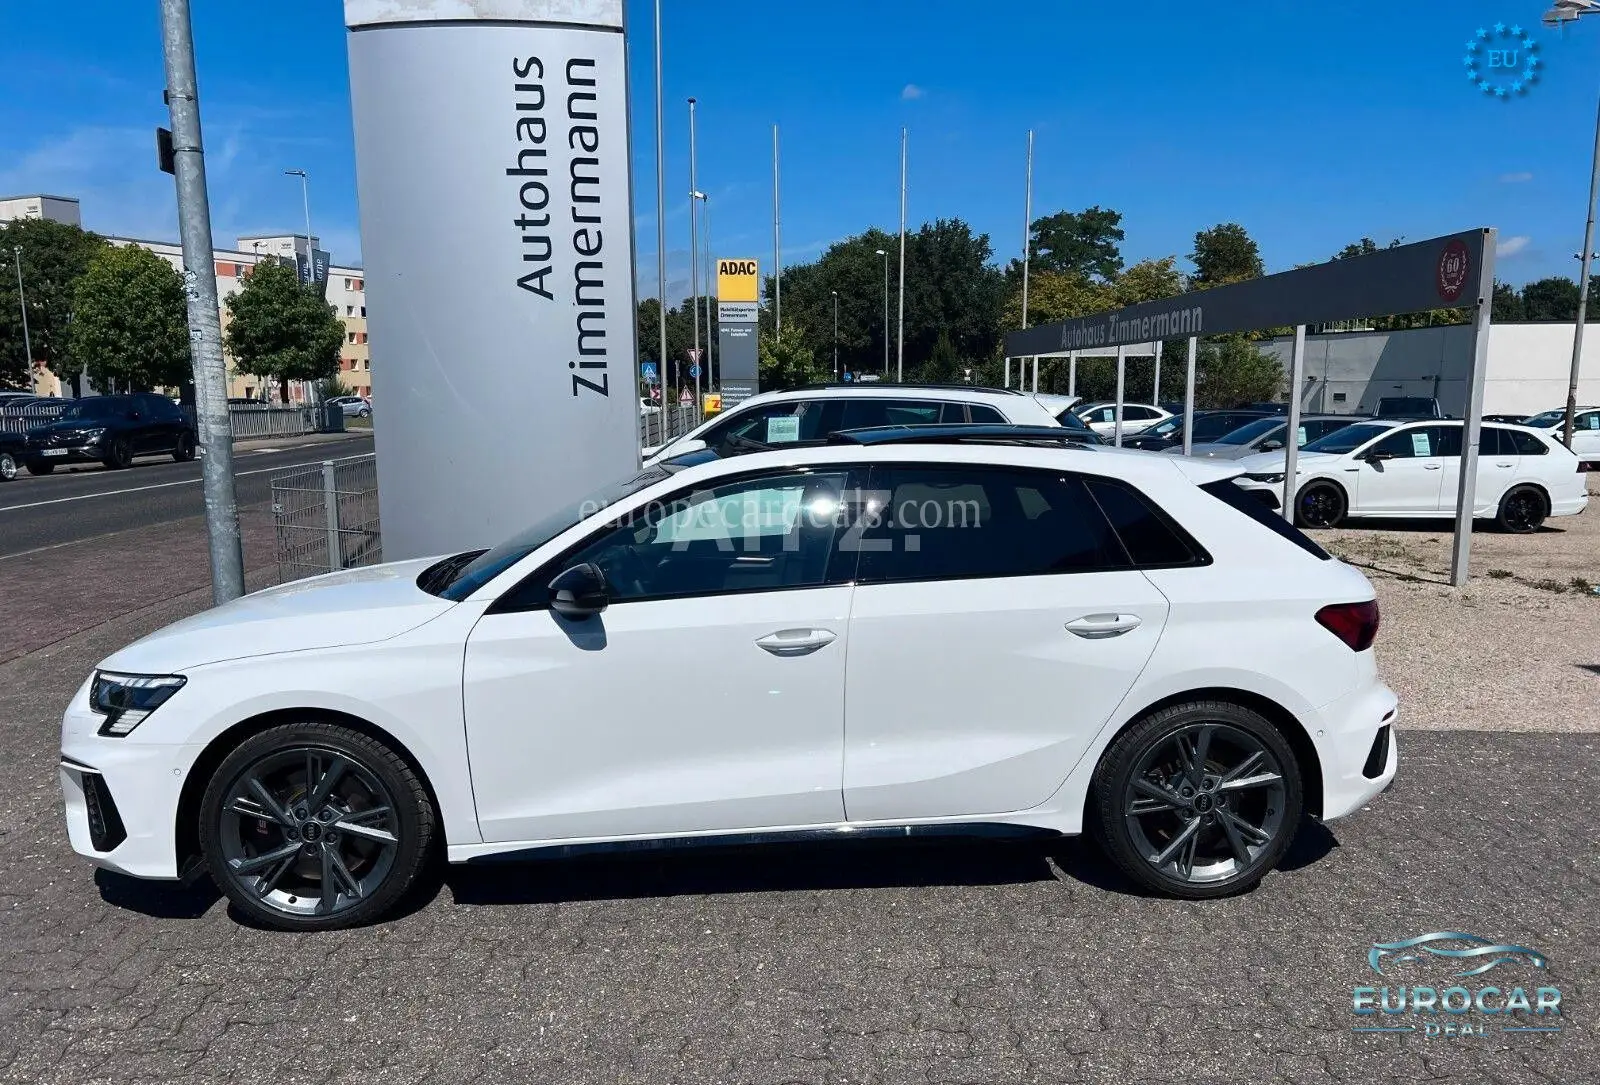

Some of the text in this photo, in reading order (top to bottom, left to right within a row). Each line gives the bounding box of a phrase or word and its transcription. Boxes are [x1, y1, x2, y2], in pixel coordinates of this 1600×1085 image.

[506, 56, 554, 300] Autohaus
[565, 57, 609, 398] Zimmermann
[719, 261, 756, 276] ADAC
[1446, 257, 1460, 274] 60
[1061, 306, 1203, 349] Autohaus Zimmermann
